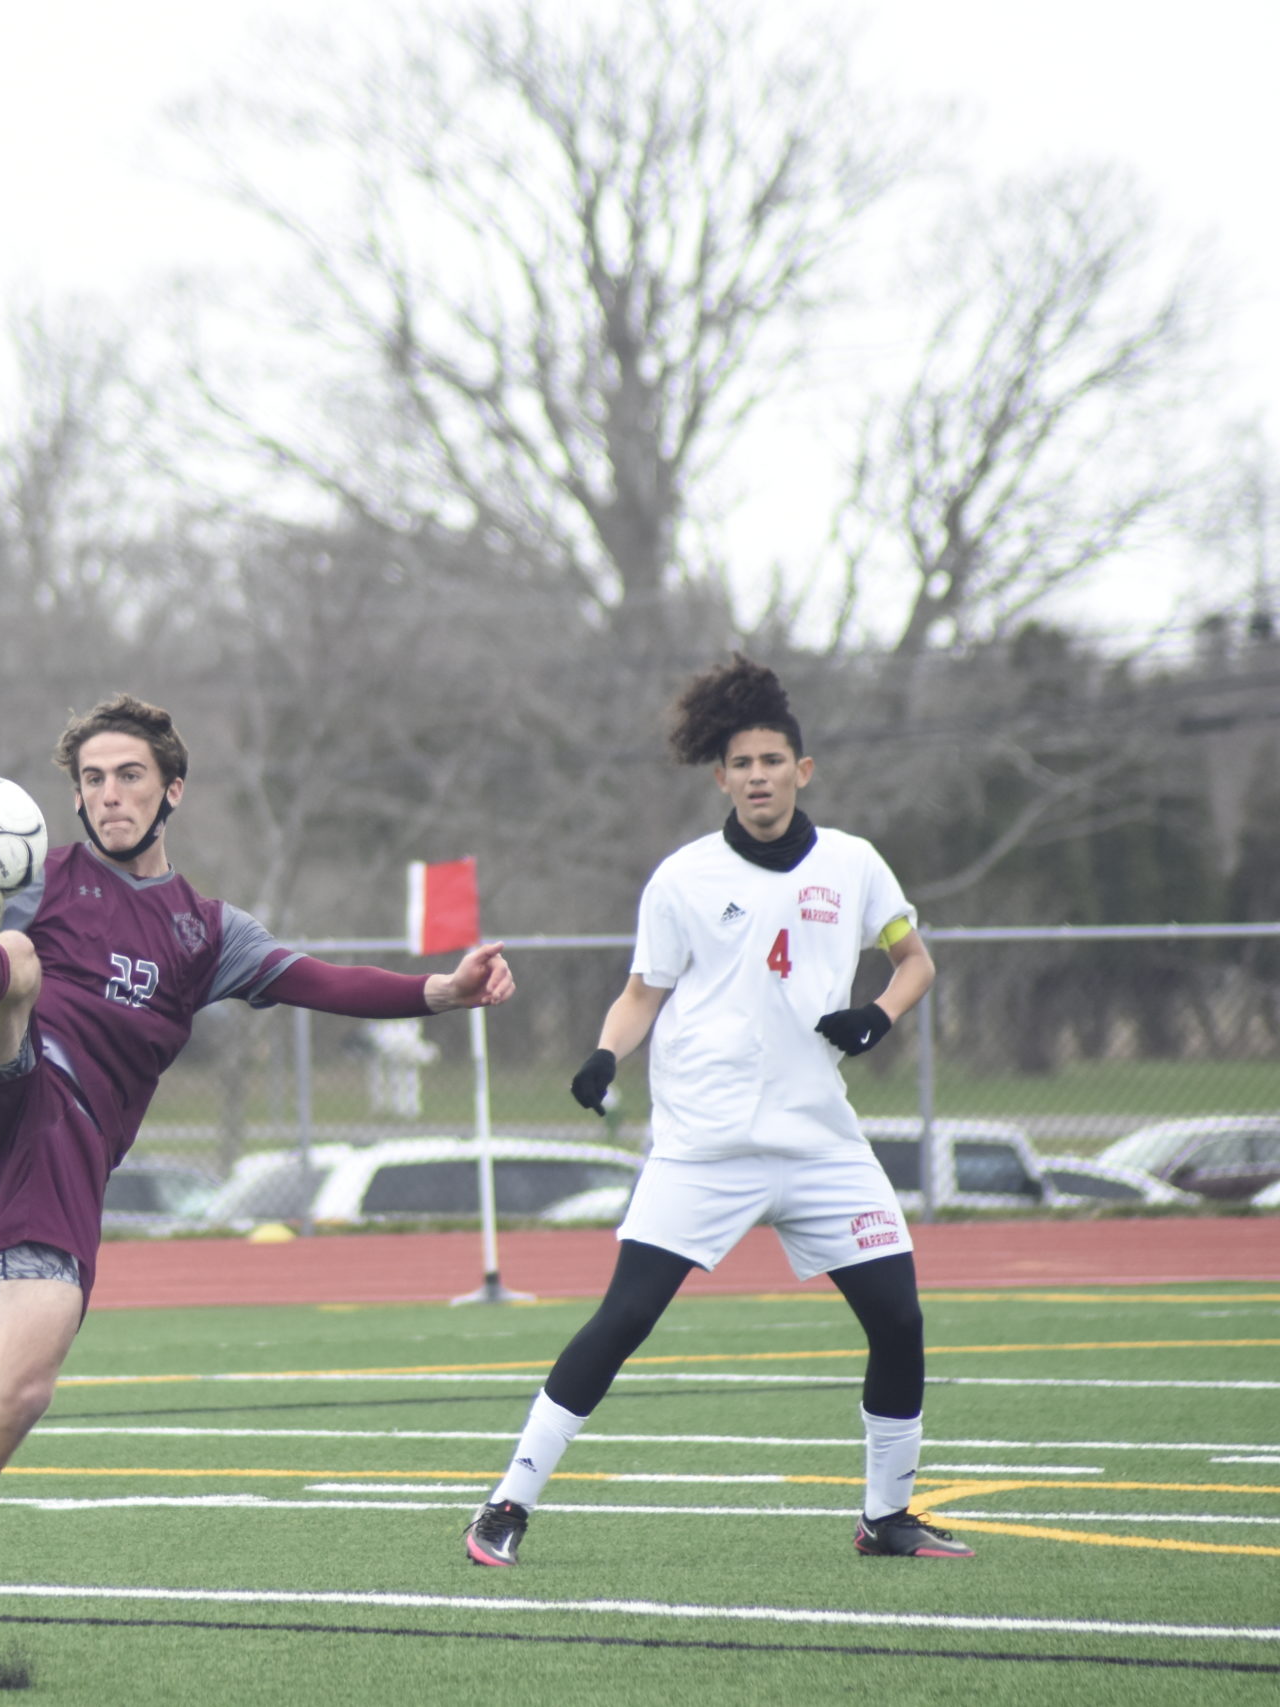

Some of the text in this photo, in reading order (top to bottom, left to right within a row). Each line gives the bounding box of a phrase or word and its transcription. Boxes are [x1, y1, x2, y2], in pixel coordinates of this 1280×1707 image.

[798, 886, 841, 909] AMITYVILLE
[801, 908, 838, 924] WARRIORS
[766, 928, 792, 979] 4
[106, 952, 159, 1008] 22
[851, 1210, 898, 1235] AMITYVILLE
[856, 1231, 899, 1250] WARRIORS
